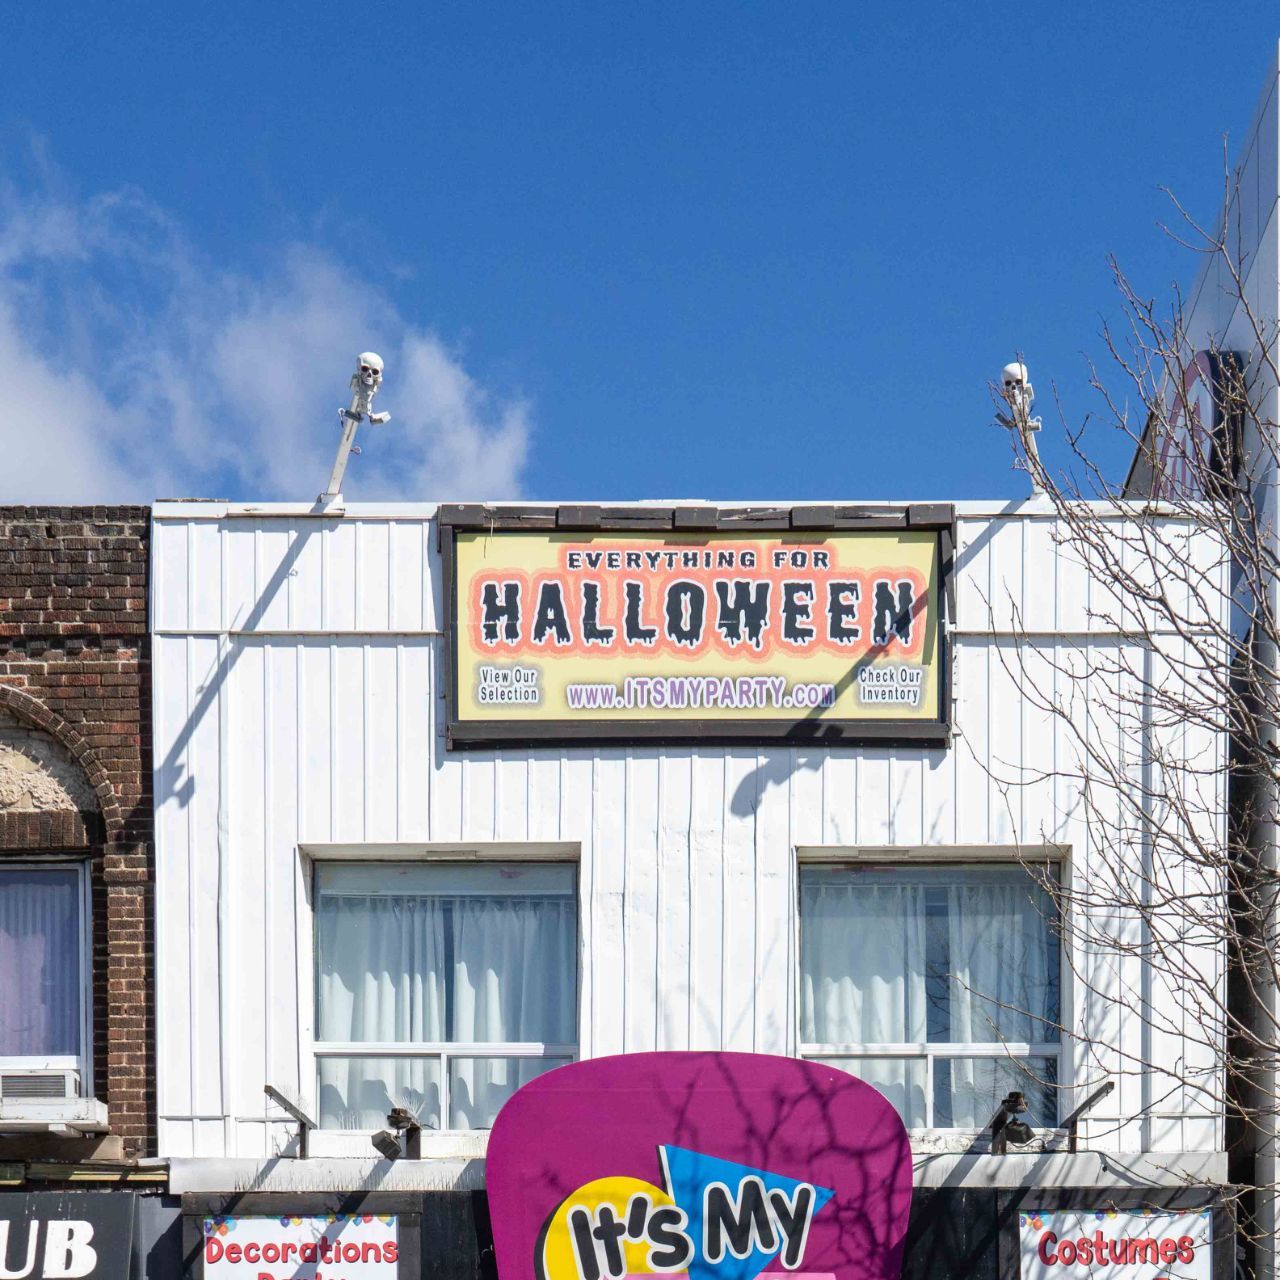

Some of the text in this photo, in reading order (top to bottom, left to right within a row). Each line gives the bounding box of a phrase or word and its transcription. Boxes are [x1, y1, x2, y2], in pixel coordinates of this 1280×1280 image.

[568, 552, 829, 571] EVERYTHING FOR
[482, 581, 915, 649] HALLOWEEN
[482, 669, 536, 683] View Our
[860, 668, 921, 683] Check Our
[481, 686, 537, 701] Selection
[862, 689, 920, 703] Inventory
[707, 1179, 811, 1267] My
[206, 1235, 399, 1264] Decorations
[1038, 1230, 1195, 1267] Costumes
